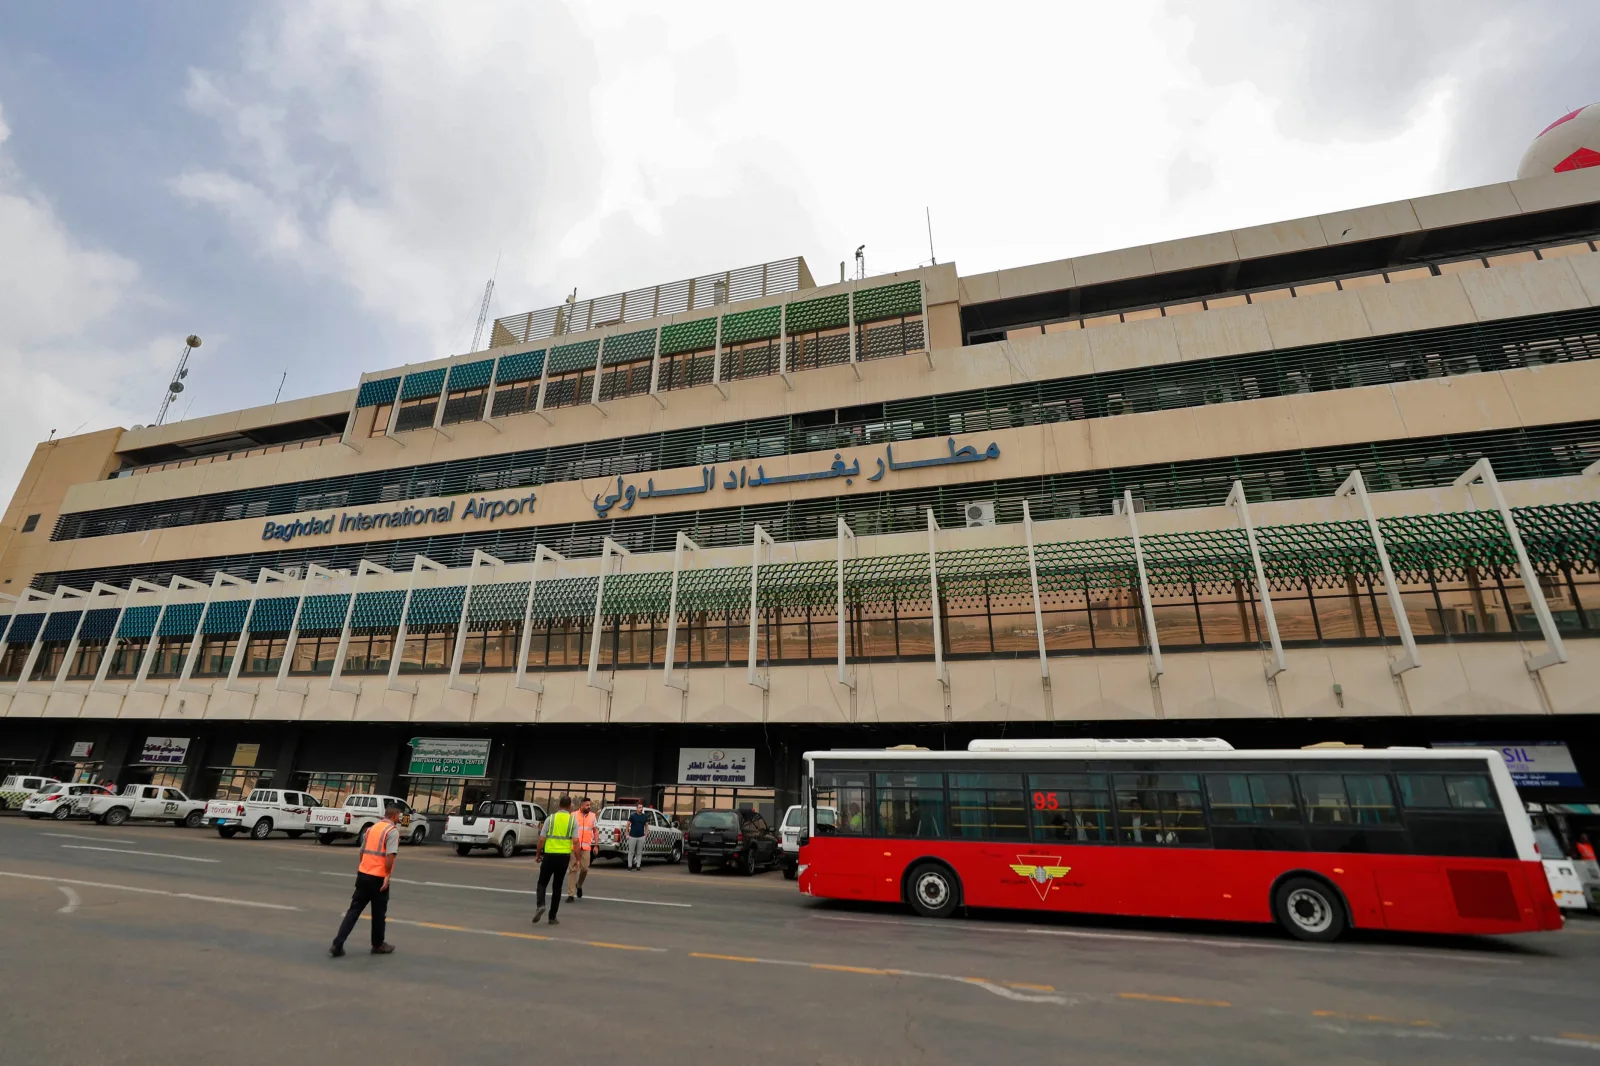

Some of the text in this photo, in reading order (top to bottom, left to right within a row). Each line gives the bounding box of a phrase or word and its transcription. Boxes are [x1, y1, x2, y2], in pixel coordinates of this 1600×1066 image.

[593, 436, 1001, 518] مطار بغداد الدولي
[261, 493, 537, 542] Baghdad International Airport
[707, 760, 729, 773] عمليات
[1033, 791, 1059, 811] 95
[211, 806, 232, 814] TOYOTA
[315, 814, 339, 822] TOYOTA
